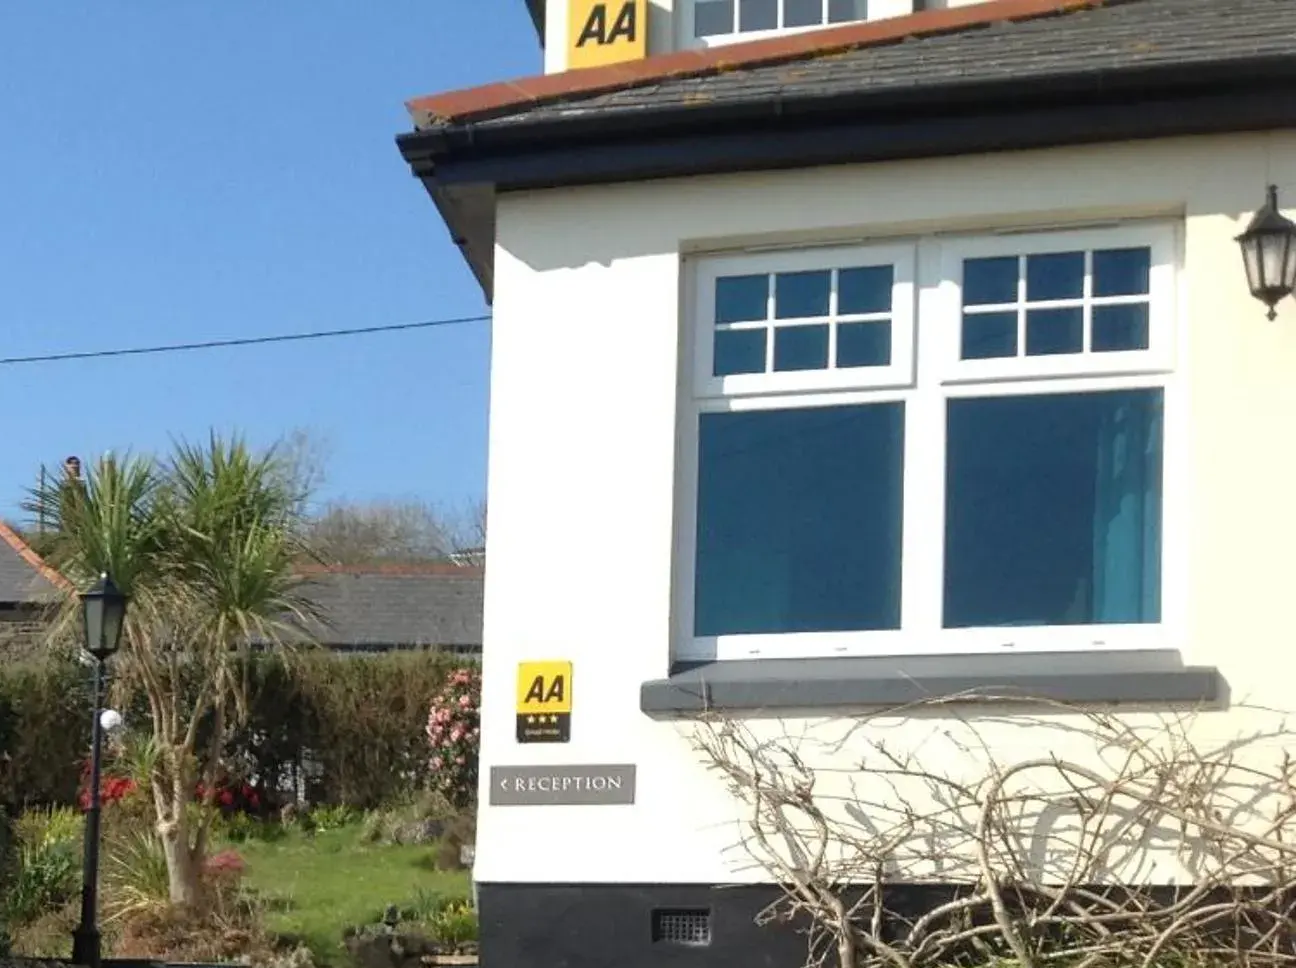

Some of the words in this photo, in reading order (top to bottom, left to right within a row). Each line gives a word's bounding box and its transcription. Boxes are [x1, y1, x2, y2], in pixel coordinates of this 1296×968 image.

[575, 2, 636, 47] AA
[524, 674, 564, 703] AA
[515, 776, 622, 792] RECEPTION
